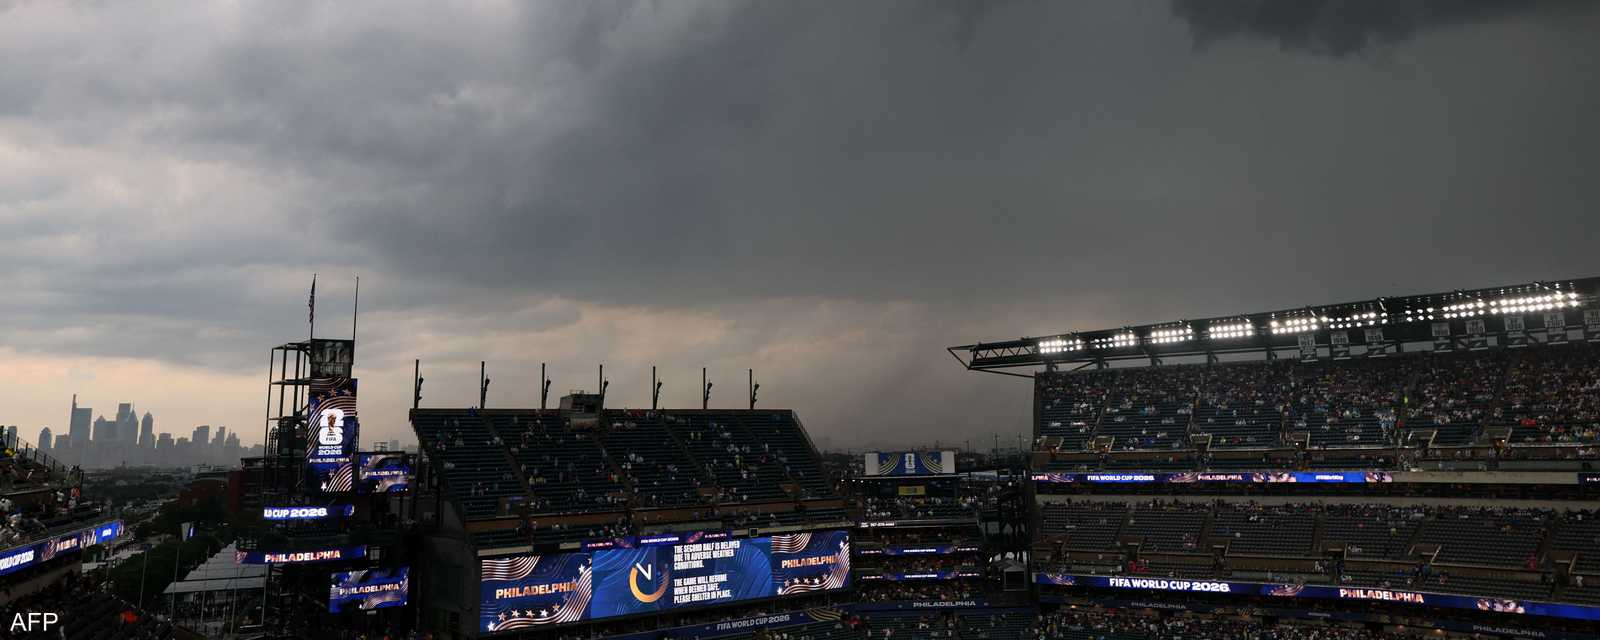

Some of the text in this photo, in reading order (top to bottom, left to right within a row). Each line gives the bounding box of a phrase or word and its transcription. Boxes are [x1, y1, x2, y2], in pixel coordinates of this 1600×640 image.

[273, 508, 289, 518] CUP
[290, 507, 328, 518] 2026
[674, 541, 740, 554] THE SECOND HALF IS DELAYED
[264, 550, 341, 563] PHILADELPHIA
[674, 549, 734, 562] DUE TO ADVERSE WEATHER
[782, 555, 839, 568] PHILADELPHIA
[674, 574, 728, 587] THE GAME WILL RESUME
[1110, 578, 1231, 593] FIFA WORLD CUP 2026
[340, 584, 400, 595] PHILADELPHIA
[496, 582, 577, 599] PHILADELPHIA
[674, 586, 689, 596] WHEN
[689, 584, 707, 593] DEEMED
[1339, 588, 1424, 604] PHILADELPHIA
[674, 594, 691, 604] PLEASE
[691, 592, 711, 602] SHELTER
[711, 591, 717, 600] IN
[1130, 601, 1187, 610] PHILADELPHIA
[716, 614, 791, 631] FIFA WORLD CUP 2026
[1472, 624, 1546, 638] PHILADELPHIA
